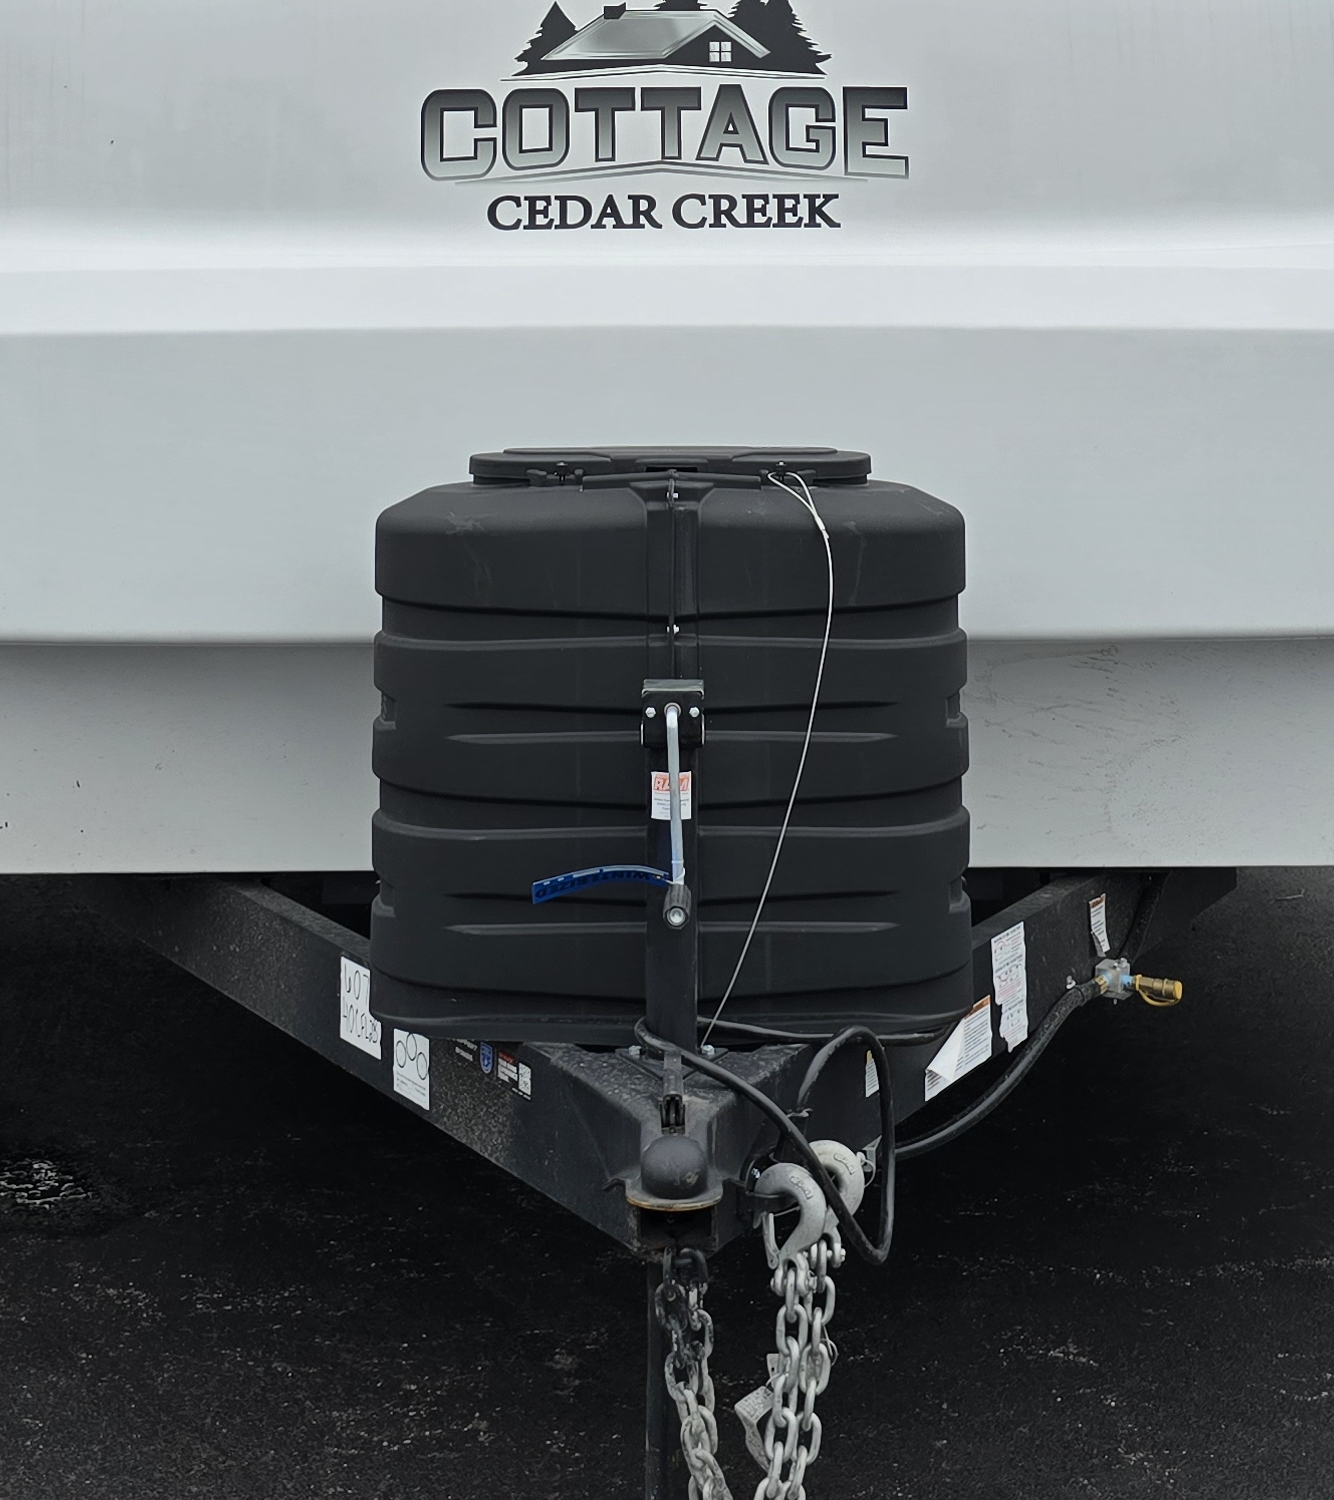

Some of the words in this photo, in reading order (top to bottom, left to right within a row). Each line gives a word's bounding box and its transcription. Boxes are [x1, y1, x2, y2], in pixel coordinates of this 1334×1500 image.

[421, 84, 909, 181] COTTAGE
[487, 193, 662, 231] CEDAR
[672, 193, 841, 229] CREEK
